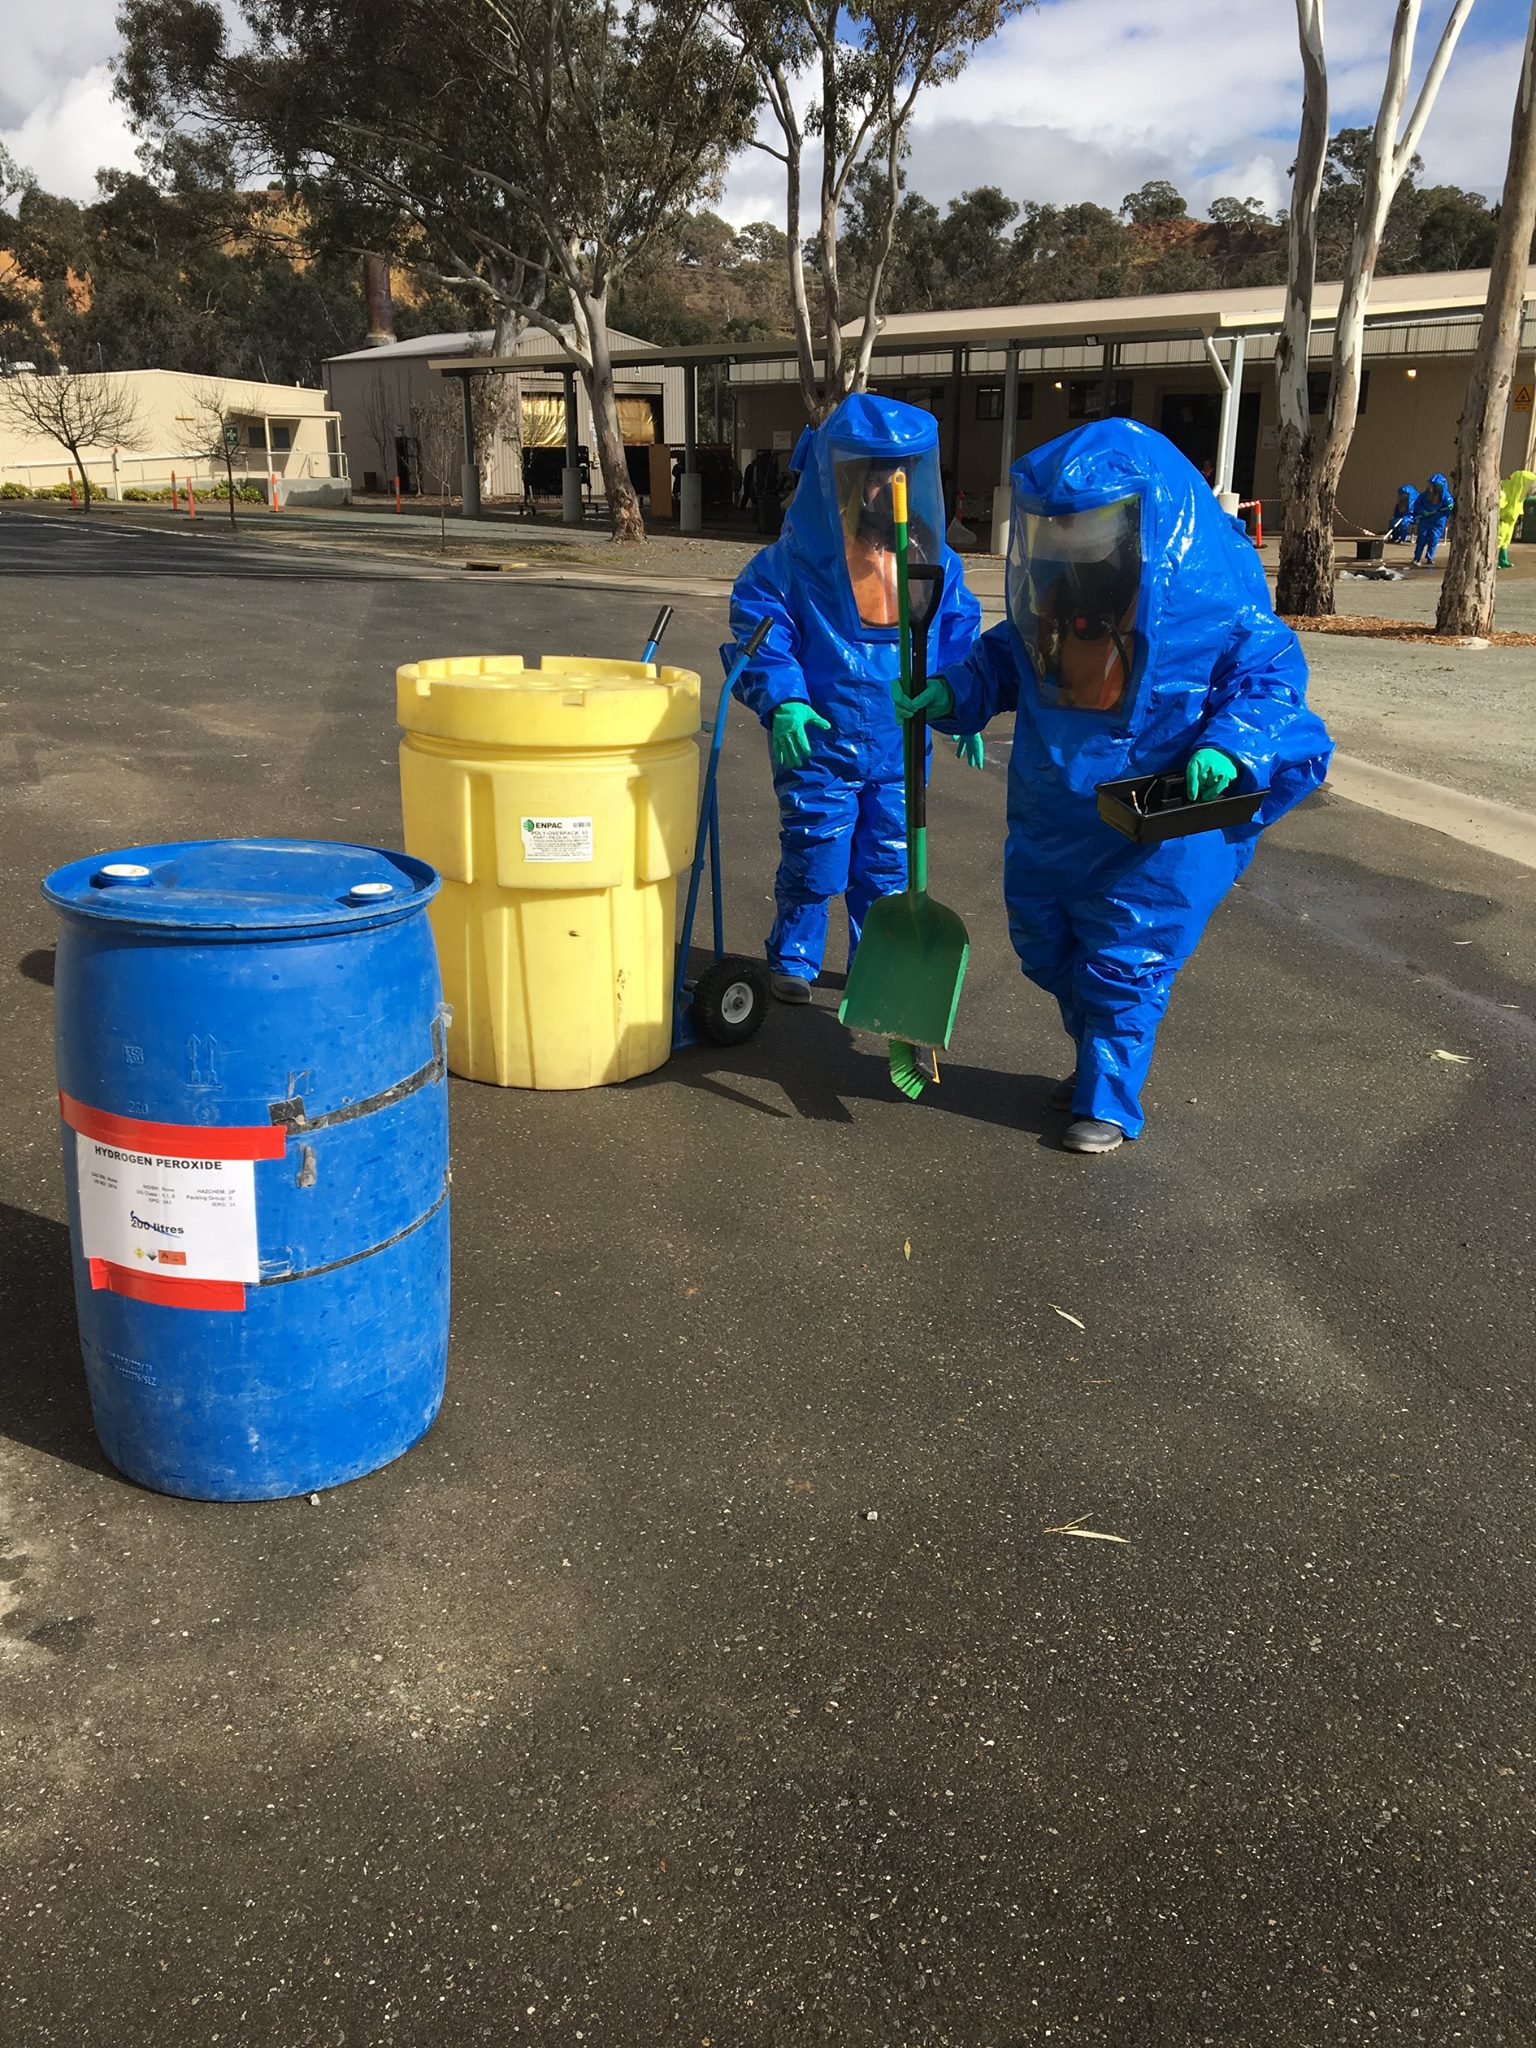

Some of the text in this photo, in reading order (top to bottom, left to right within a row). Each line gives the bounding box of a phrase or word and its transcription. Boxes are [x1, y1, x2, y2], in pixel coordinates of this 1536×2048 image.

[94, 1145, 223, 1170] HYDROGEN PEROXIDE
[130, 1219, 184, 1234] 200 litres
